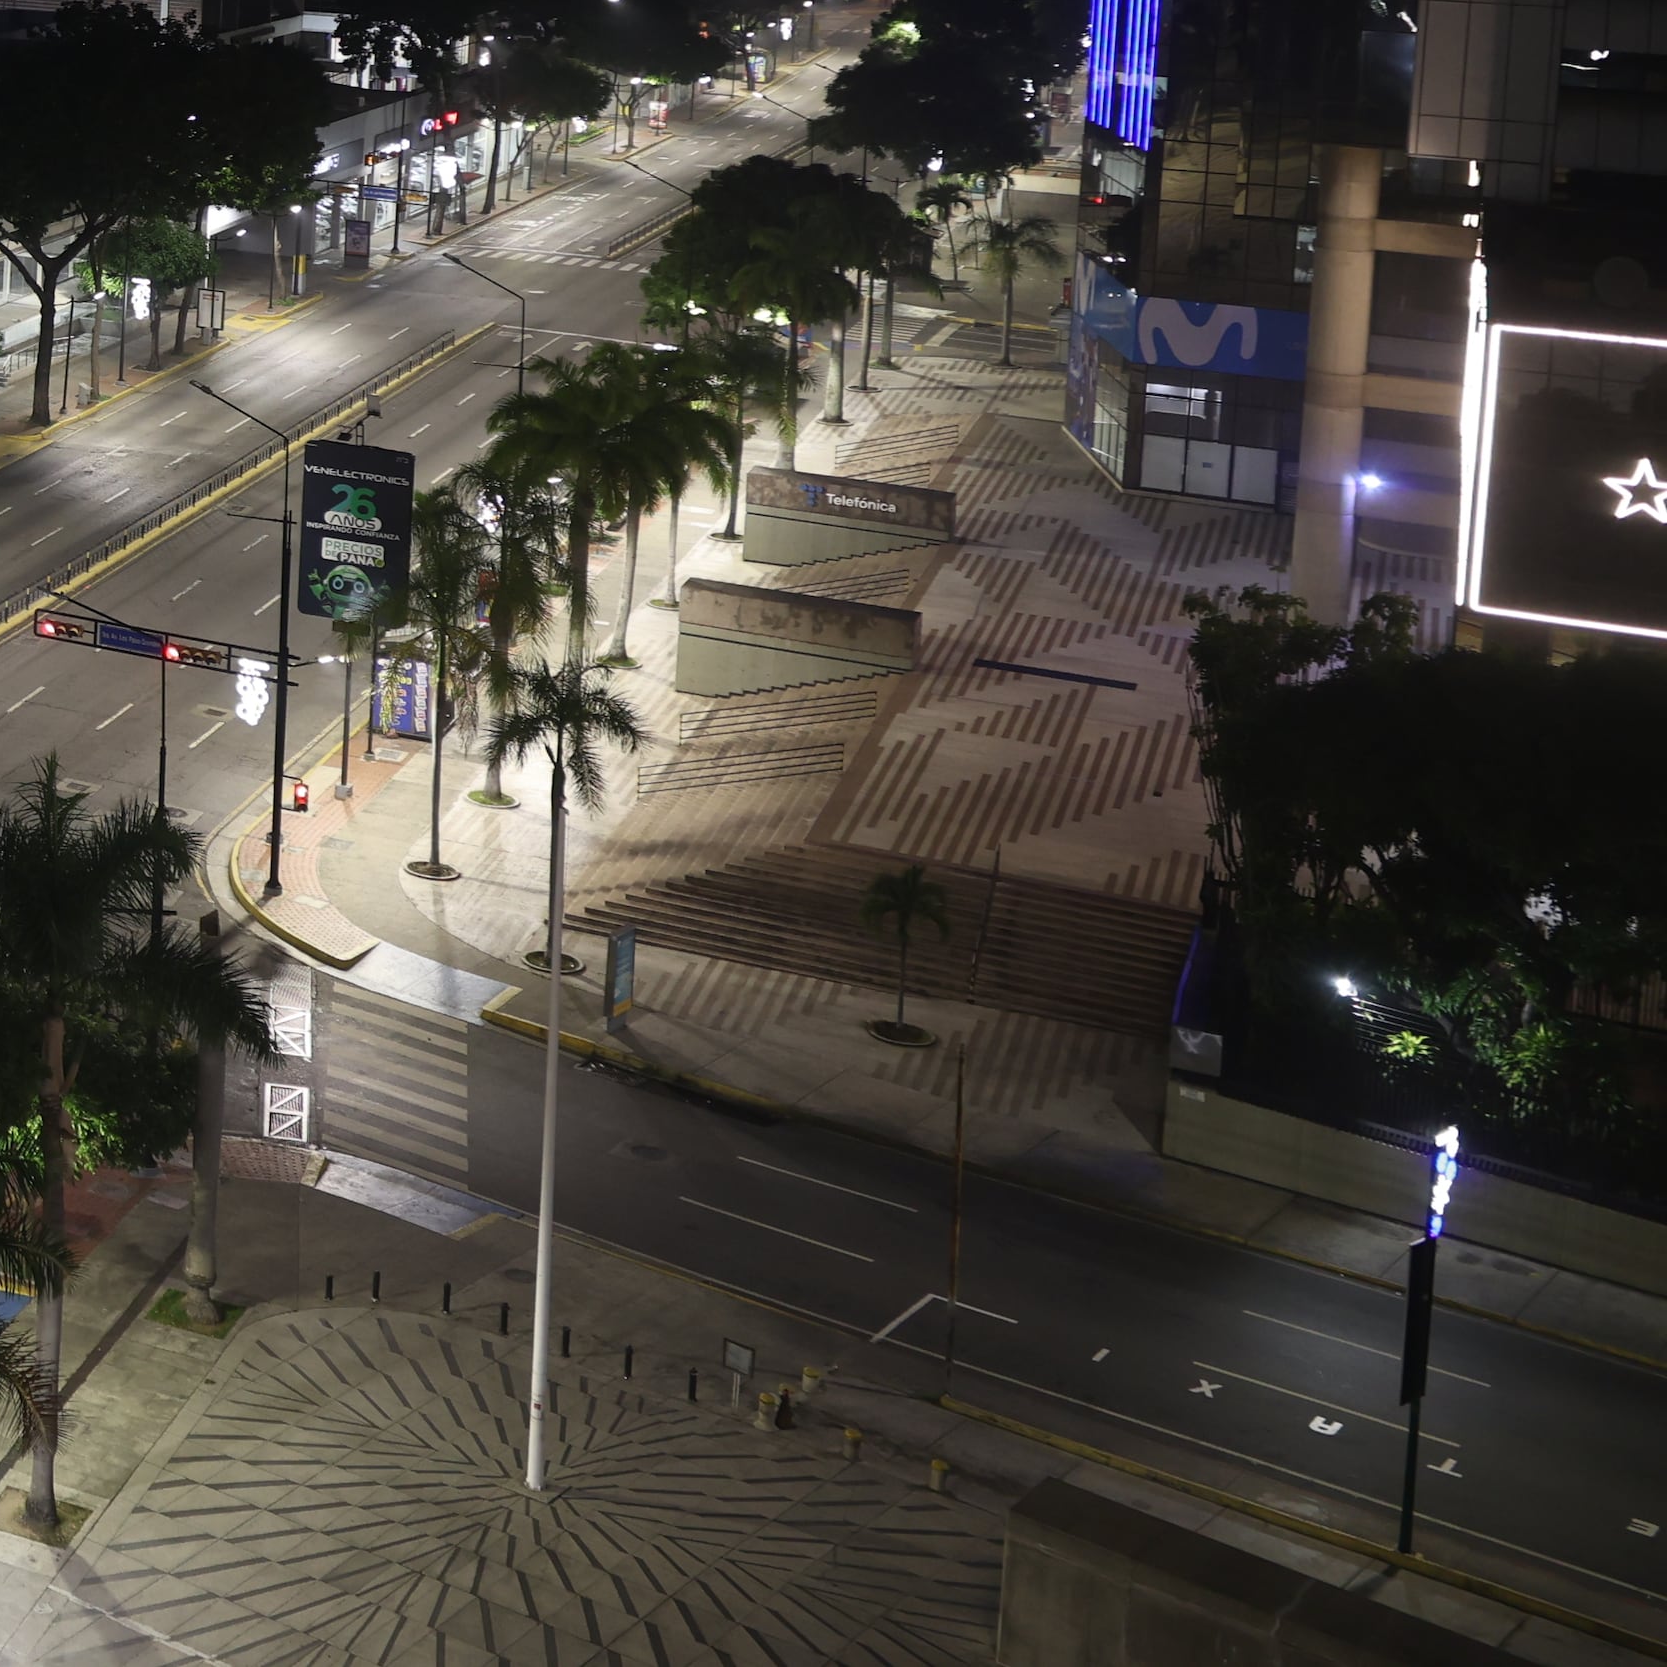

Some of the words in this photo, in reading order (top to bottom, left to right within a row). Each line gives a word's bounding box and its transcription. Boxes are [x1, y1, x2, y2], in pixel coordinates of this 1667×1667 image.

[304, 464, 410, 486] VENELECTRONICS
[331, 483, 377, 521] 26
[825, 493, 897, 513] Telefónica
[306, 521, 353, 535] INSPIRANDO
[354, 529, 400, 542] CONFIANZA
[325, 539, 383, 557] PRECIOS
